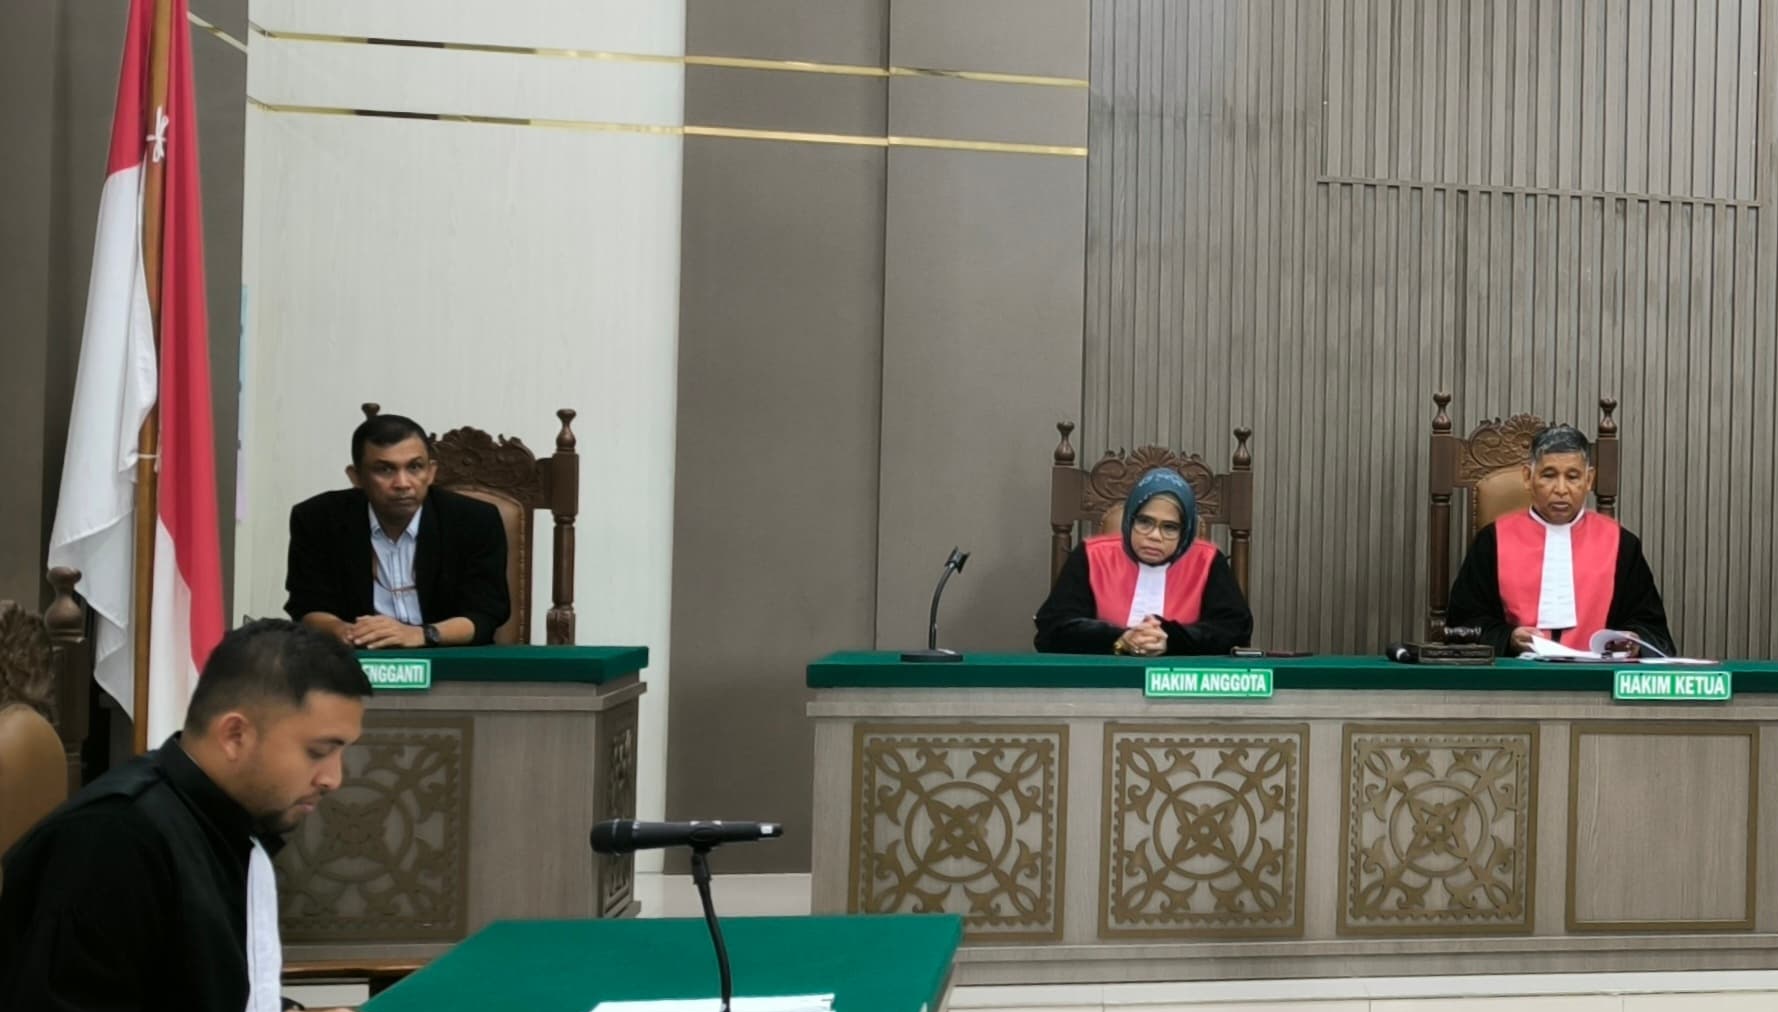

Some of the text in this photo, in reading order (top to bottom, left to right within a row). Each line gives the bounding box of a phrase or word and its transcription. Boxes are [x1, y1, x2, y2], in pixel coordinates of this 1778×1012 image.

[1151, 673, 1266, 692] HAKIM ANGGOTA
[1620, 675, 1725, 695] HAKIM KETUA
